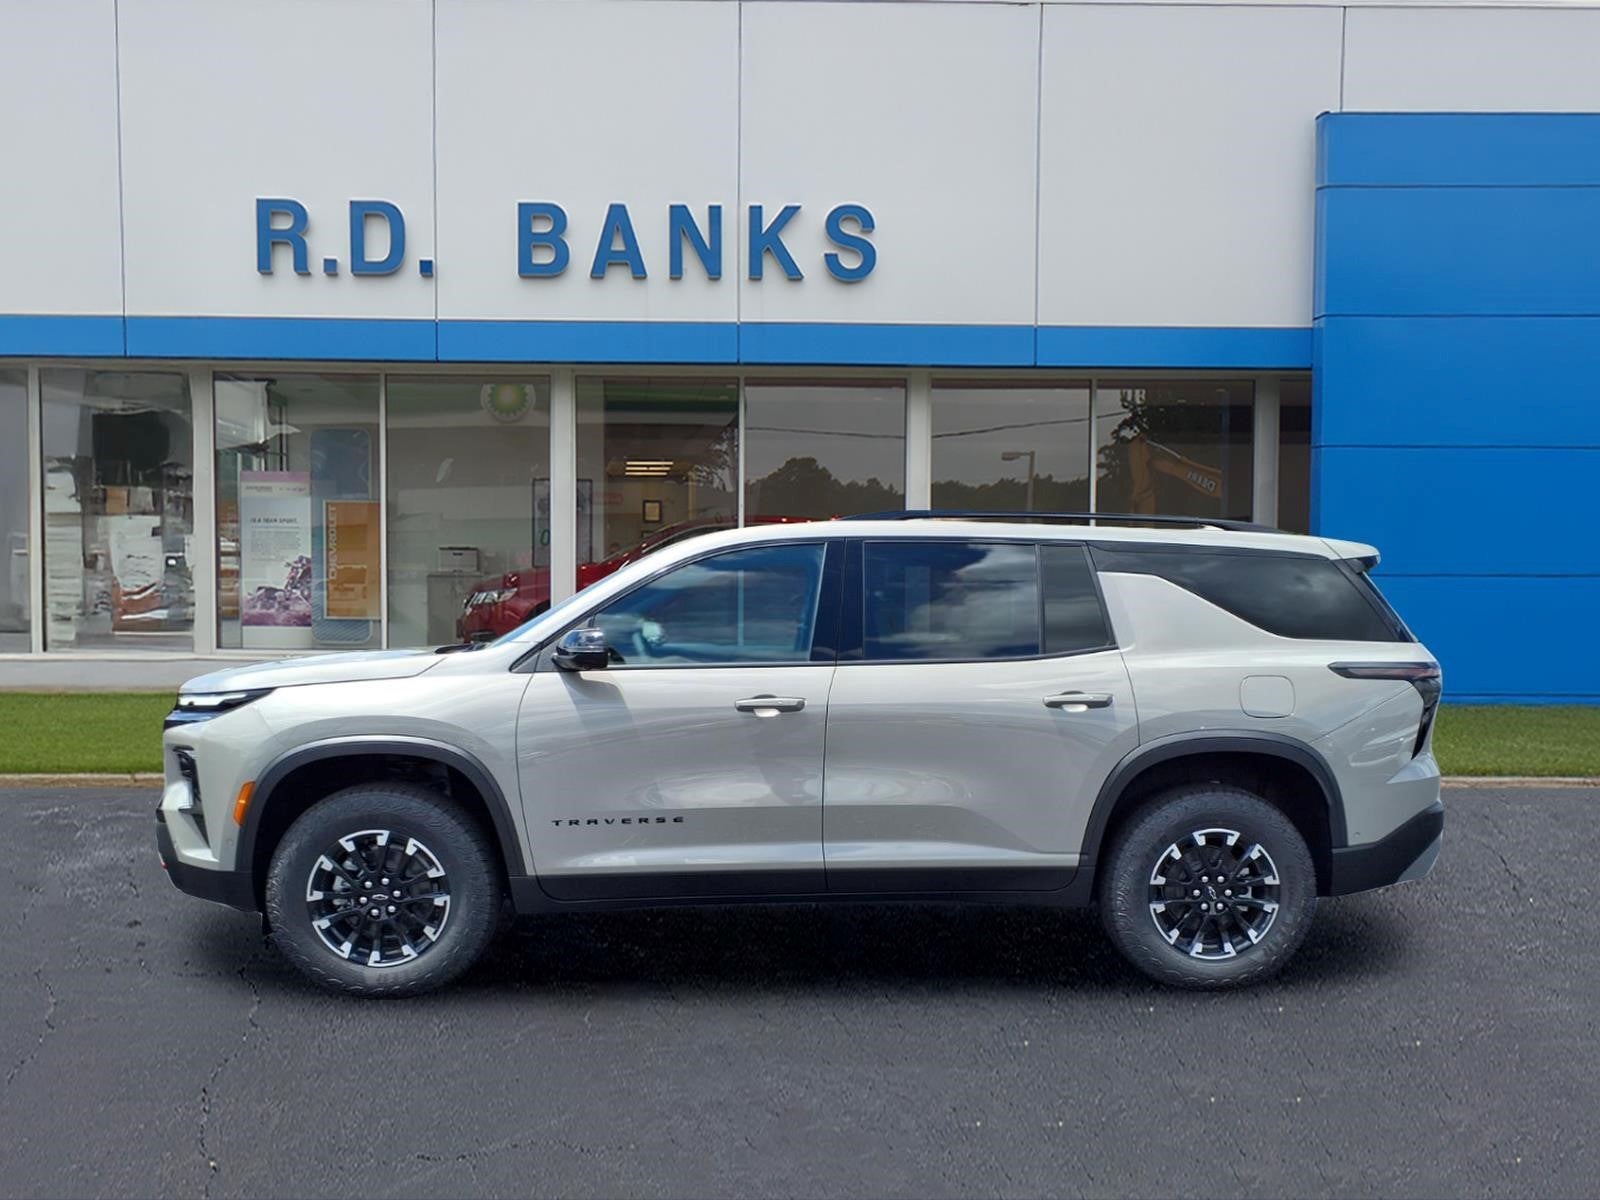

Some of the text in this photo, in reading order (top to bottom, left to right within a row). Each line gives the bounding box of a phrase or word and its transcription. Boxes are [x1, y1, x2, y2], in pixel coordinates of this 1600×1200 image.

[256, 198, 878, 283] R.D. BANKS
[328, 504, 337, 580] CHEVROLET
[552, 816, 684, 826] TRAVERSE
